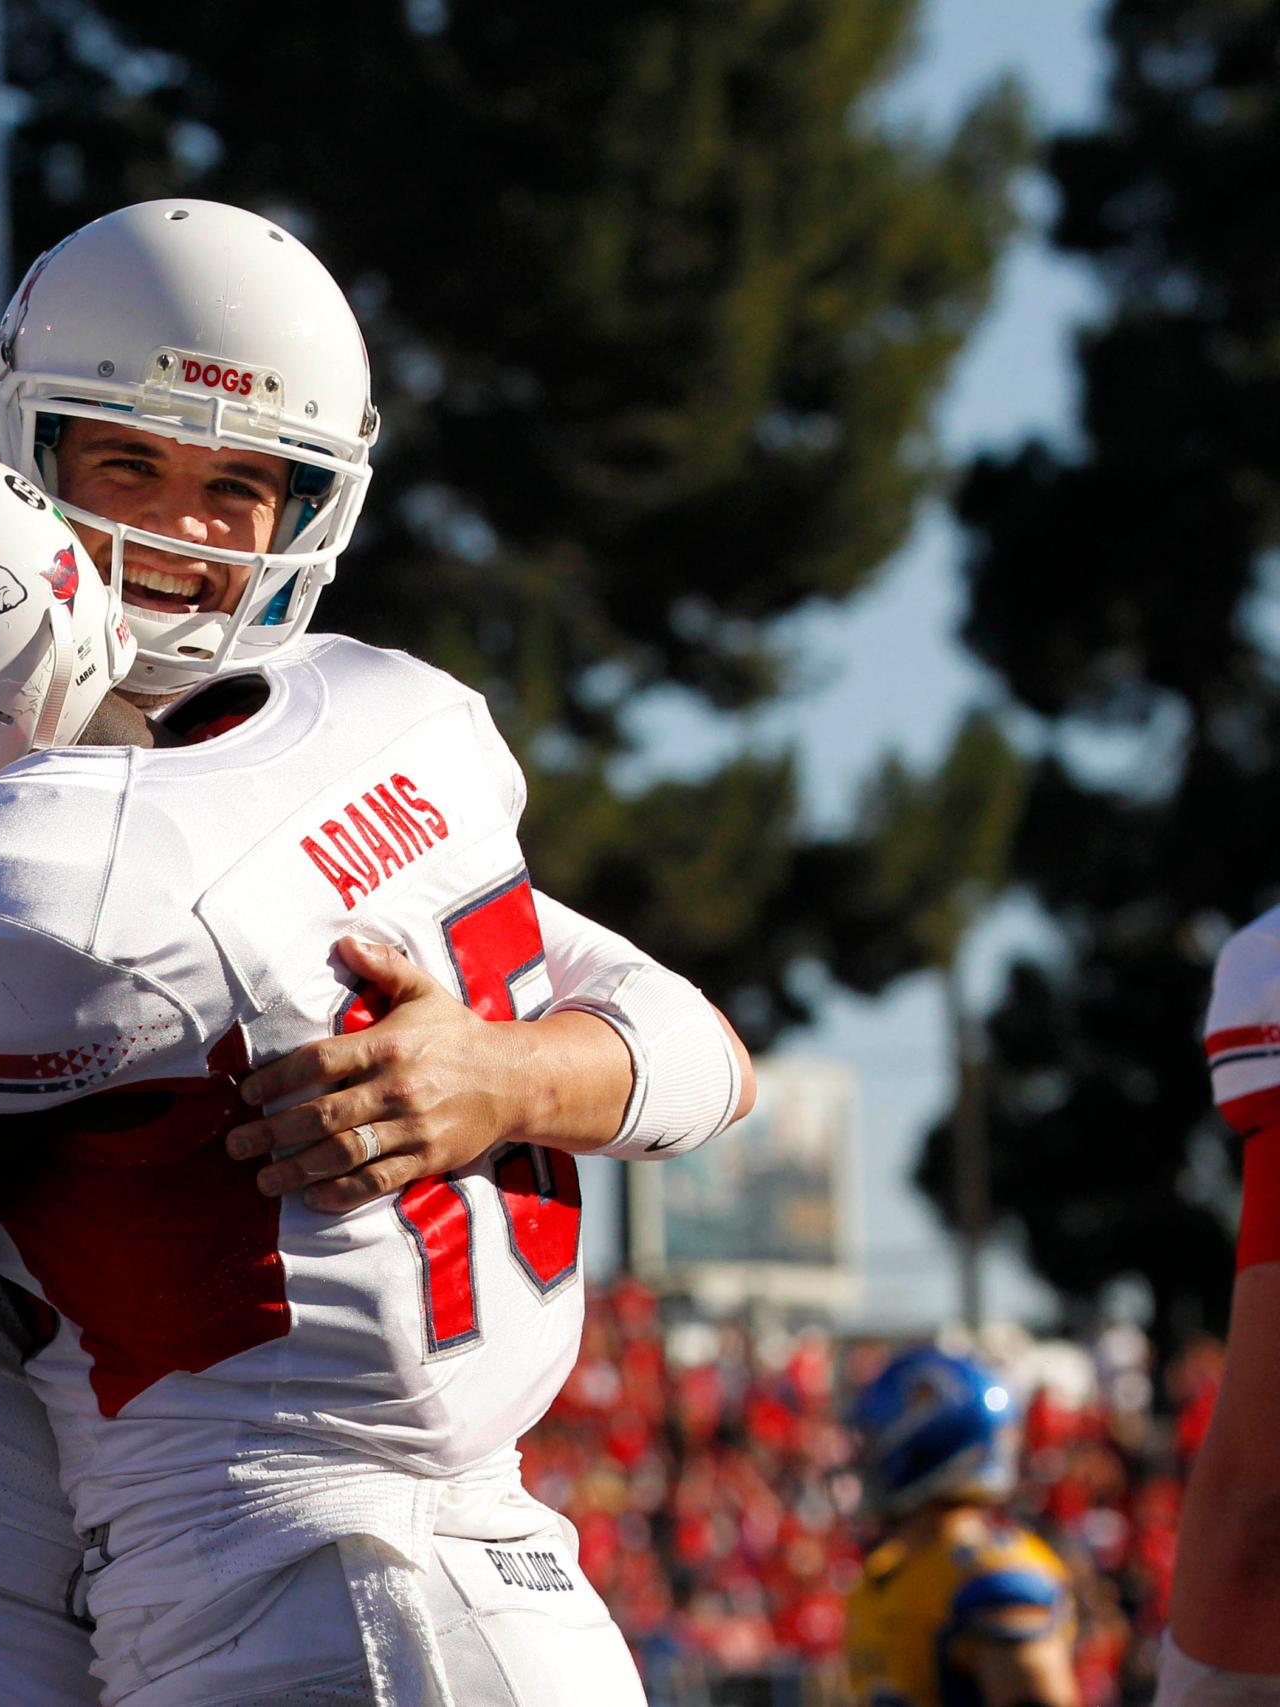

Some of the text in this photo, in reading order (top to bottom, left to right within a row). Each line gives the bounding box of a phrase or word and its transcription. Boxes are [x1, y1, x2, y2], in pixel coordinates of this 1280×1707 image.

[182, 359, 253, 395] 'DOGS
[75, 663, 97, 687] LARGE
[299, 773, 449, 911] ADAMS
[484, 1548, 574, 1592] BULLDOGS
